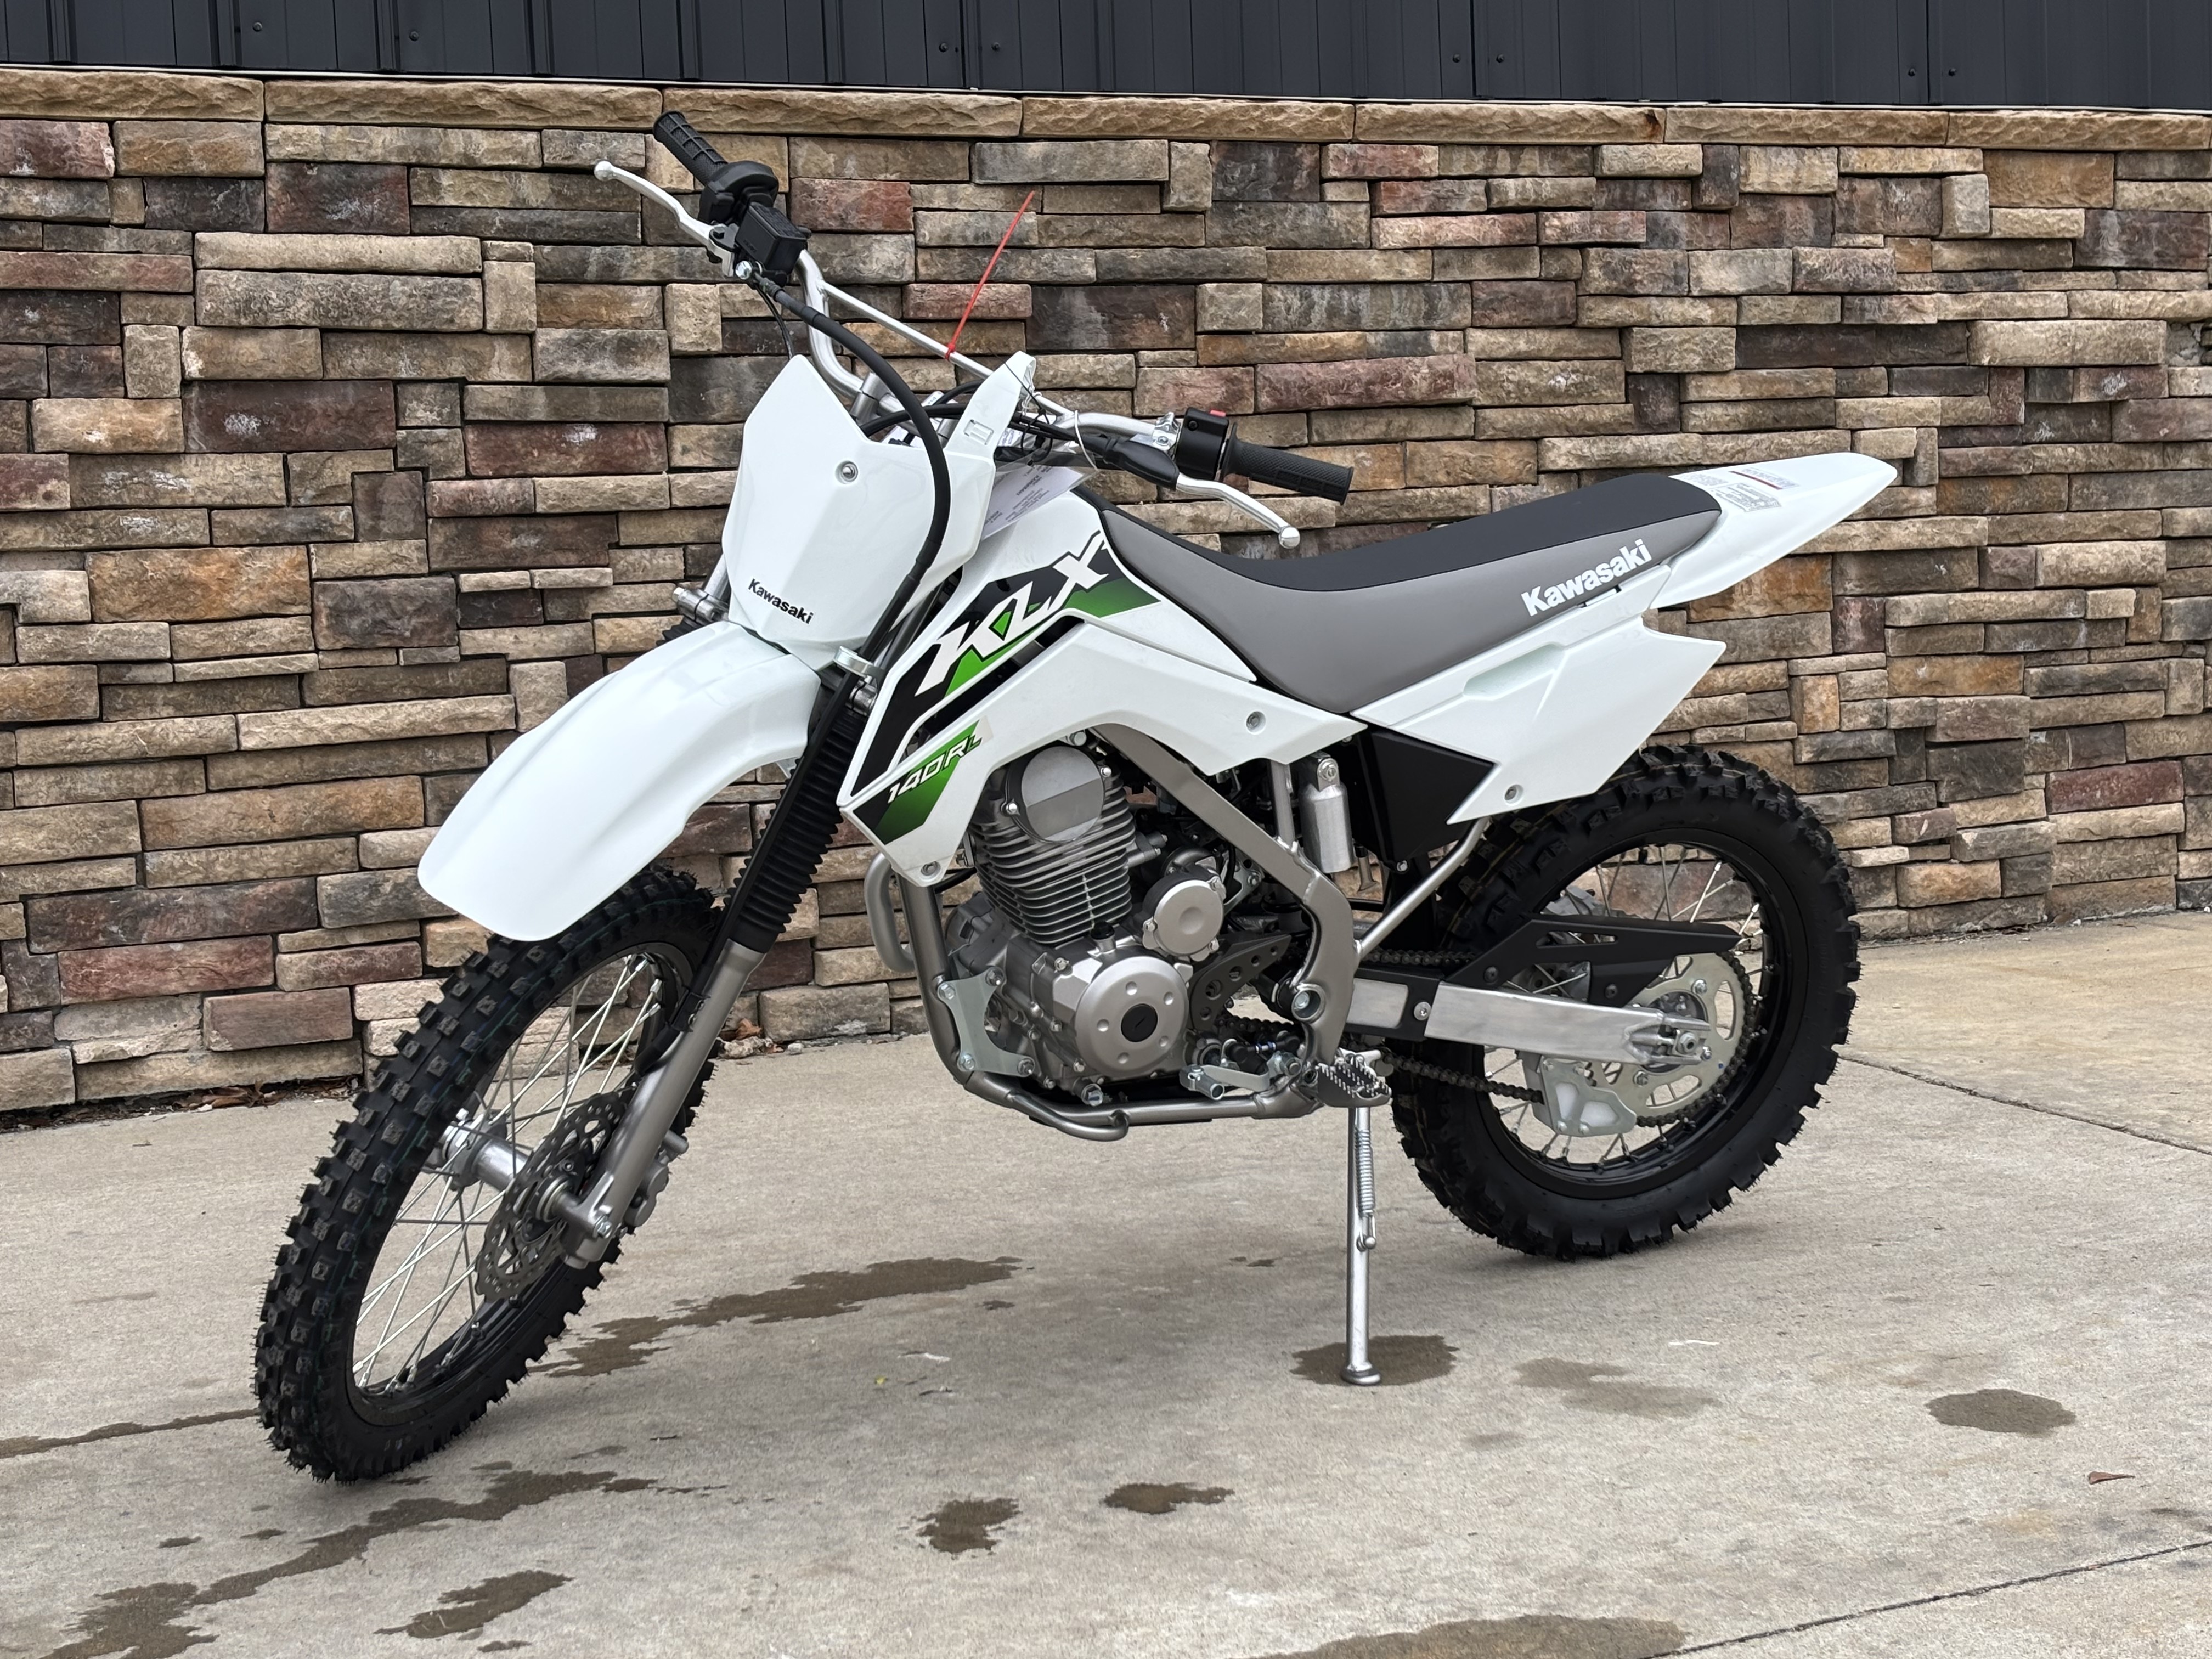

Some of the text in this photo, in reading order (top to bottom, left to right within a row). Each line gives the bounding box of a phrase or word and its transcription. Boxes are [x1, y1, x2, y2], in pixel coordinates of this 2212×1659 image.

[748, 578, 814, 625] Kawasaki
[914, 530, 1109, 697] KLX
[1521, 538, 1652, 617] Kawasaki
